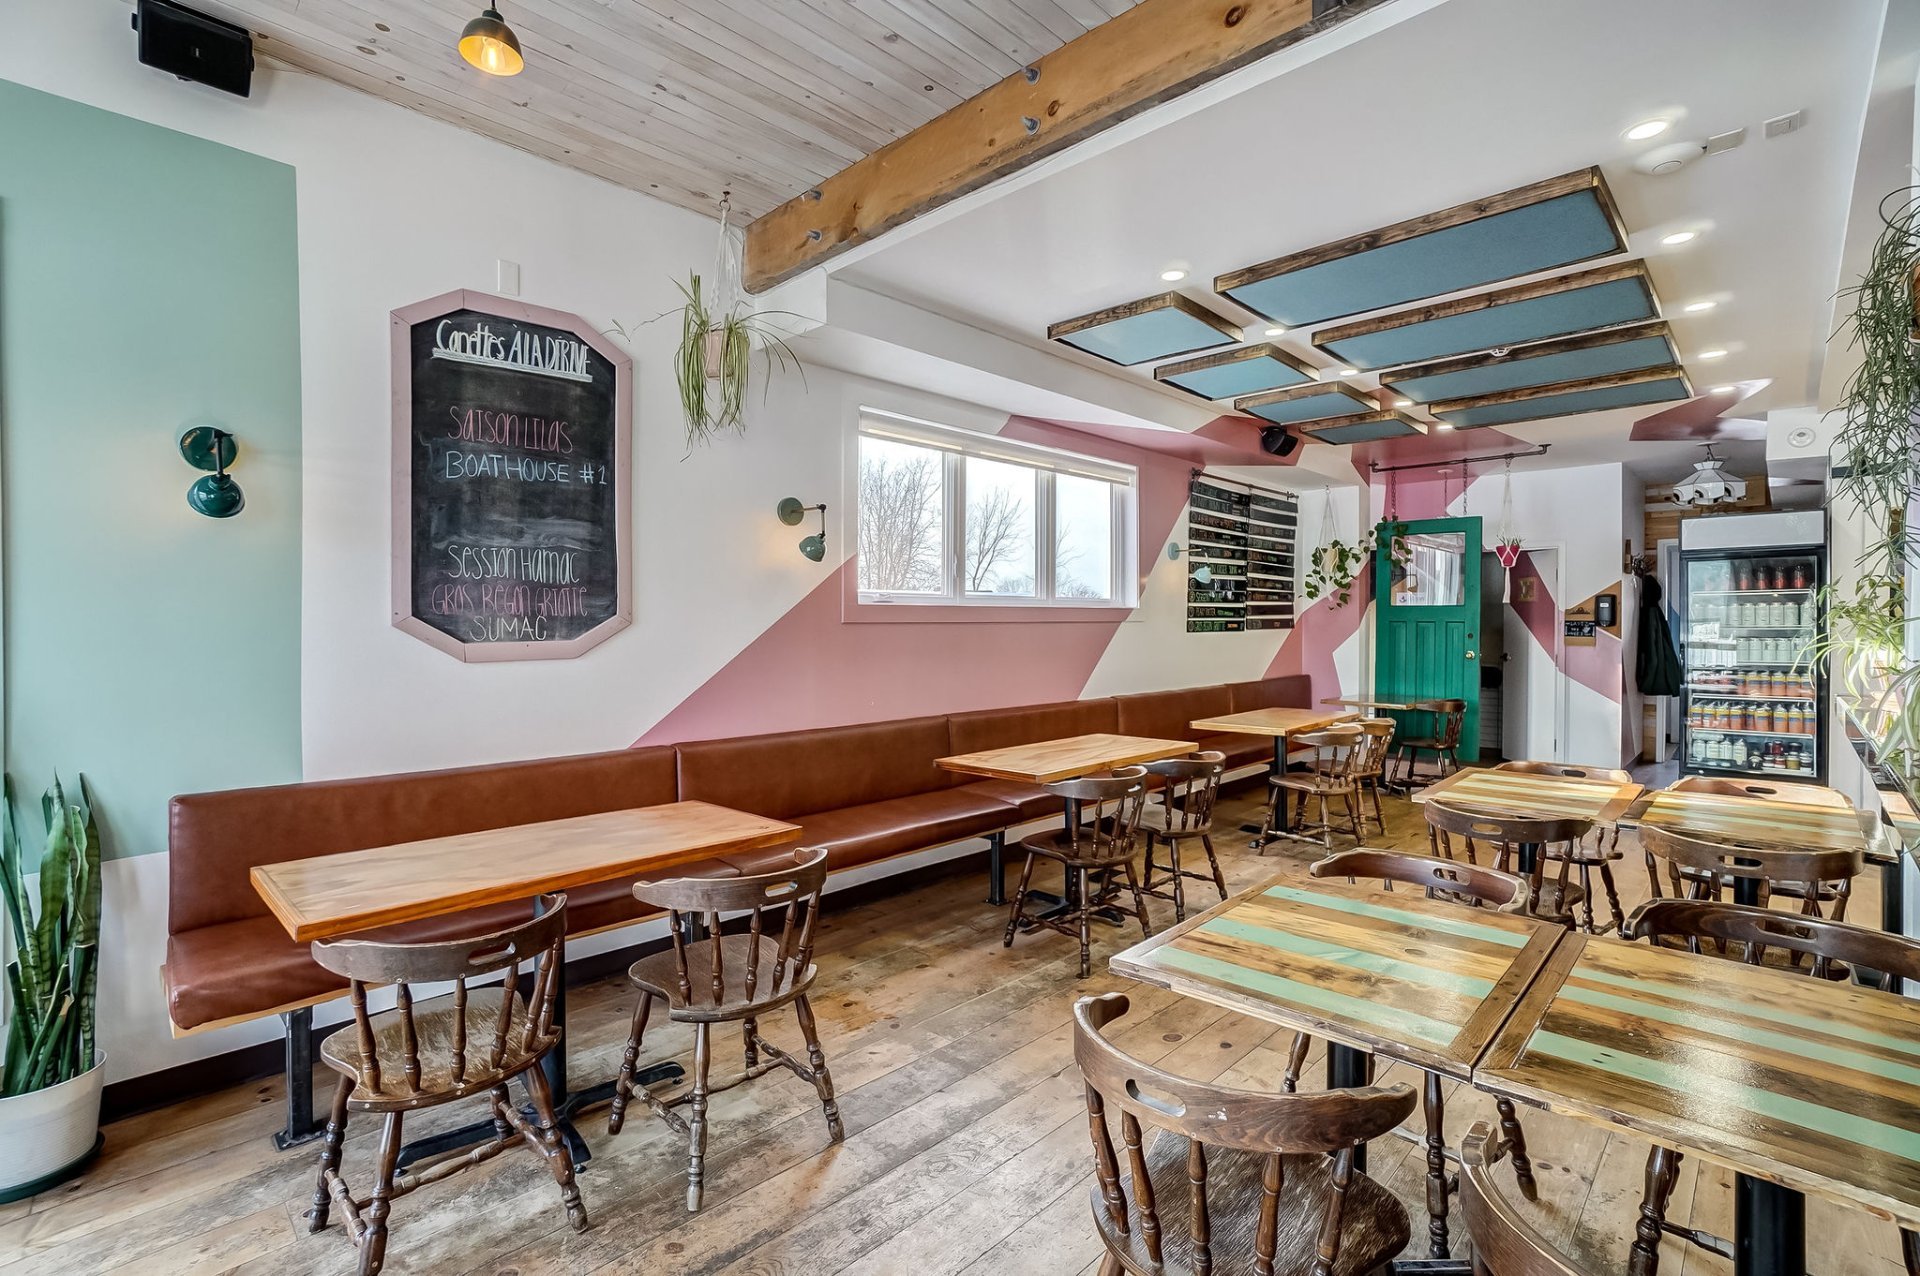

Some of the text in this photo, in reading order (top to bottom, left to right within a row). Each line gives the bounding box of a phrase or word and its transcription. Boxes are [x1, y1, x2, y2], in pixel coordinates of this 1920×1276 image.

[436, 319, 506, 360] Canettes
[446, 451, 570, 482] BOATHOUSE
[432, 584, 474, 615] GROS
[469, 616, 547, 641] SUMAC
